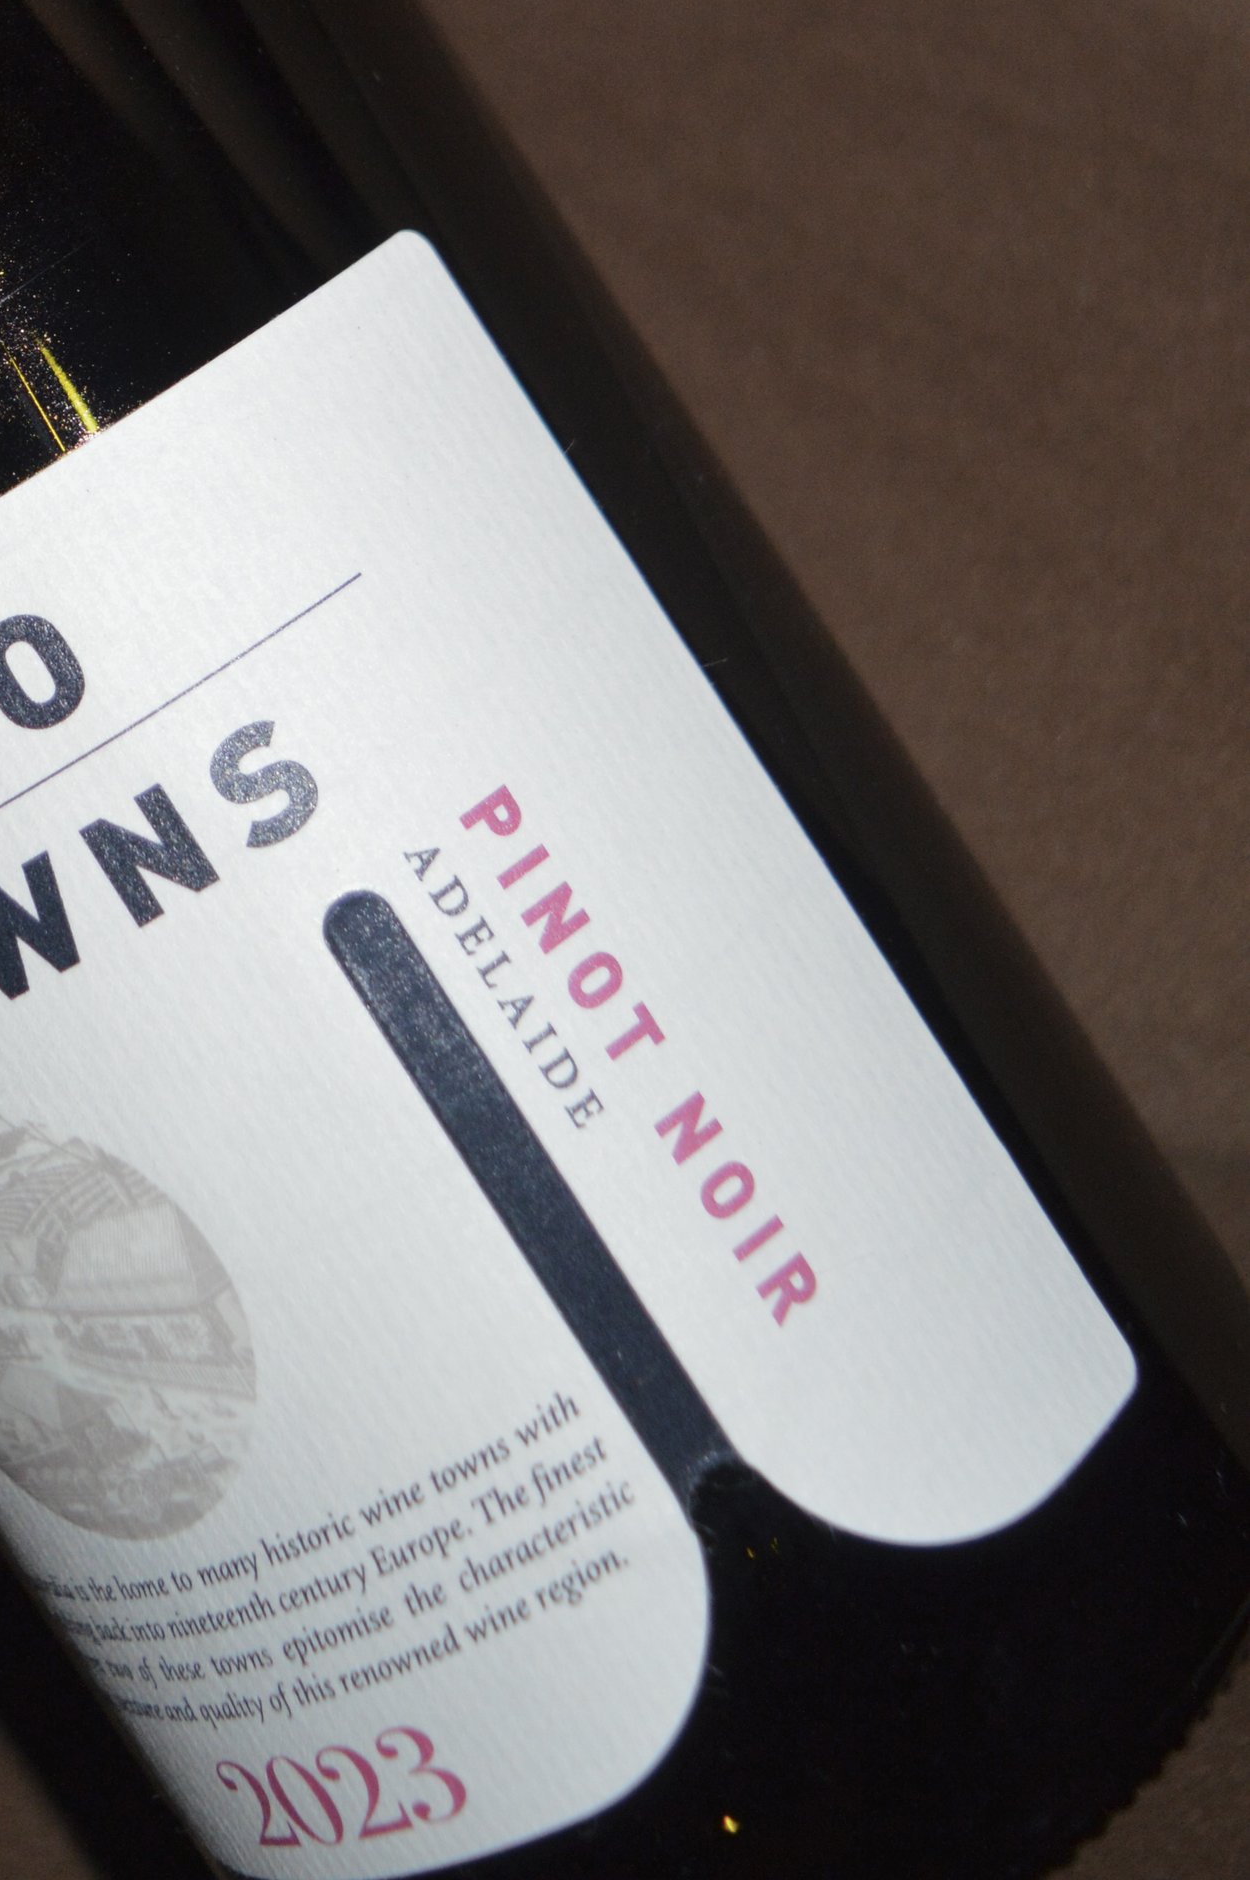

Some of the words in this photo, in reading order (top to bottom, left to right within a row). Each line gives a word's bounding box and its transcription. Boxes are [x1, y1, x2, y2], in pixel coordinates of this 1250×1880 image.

[402, 843, 606, 1132] ADELAIDE
[458, 784, 666, 1062] PINOT
[653, 1091, 820, 1328] NOIR
[88, 1576, 114, 1602] the
[113, 1574, 169, 1601] home
[170, 1570, 193, 1593] to
[197, 1551, 259, 1587] many
[260, 1511, 356, 1566] historic
[359, 1480, 426, 1528] wine
[429, 1436, 512, 1494] towns
[515, 1391, 582, 1448] with
[127, 1617, 166, 1641] into
[168, 1590, 276, 1639] nineteenth
[279, 1560, 367, 1613] century
[369, 1516, 475, 1578] Europe.
[470, 1484, 531, 1527] The
[531, 1434, 609, 1508] finest
[138, 1656, 159, 1691] of
[159, 1654, 206, 1682] these
[211, 1647, 274, 1678] towns
[282, 1601, 395, 1666] epitomise
[403, 1580, 448, 1617] the
[458, 1477, 636, 1594] characteristic
[164, 1696, 198, 1722] and
[201, 1691, 265, 1731] quality
[269, 1681, 293, 1720] of
[292, 1666, 337, 1708] this
[339, 1623, 462, 1697] renowned
[464, 1594, 532, 1644] wine
[534, 1547, 631, 1608] region.
[215, 1724, 468, 1848] 2023
